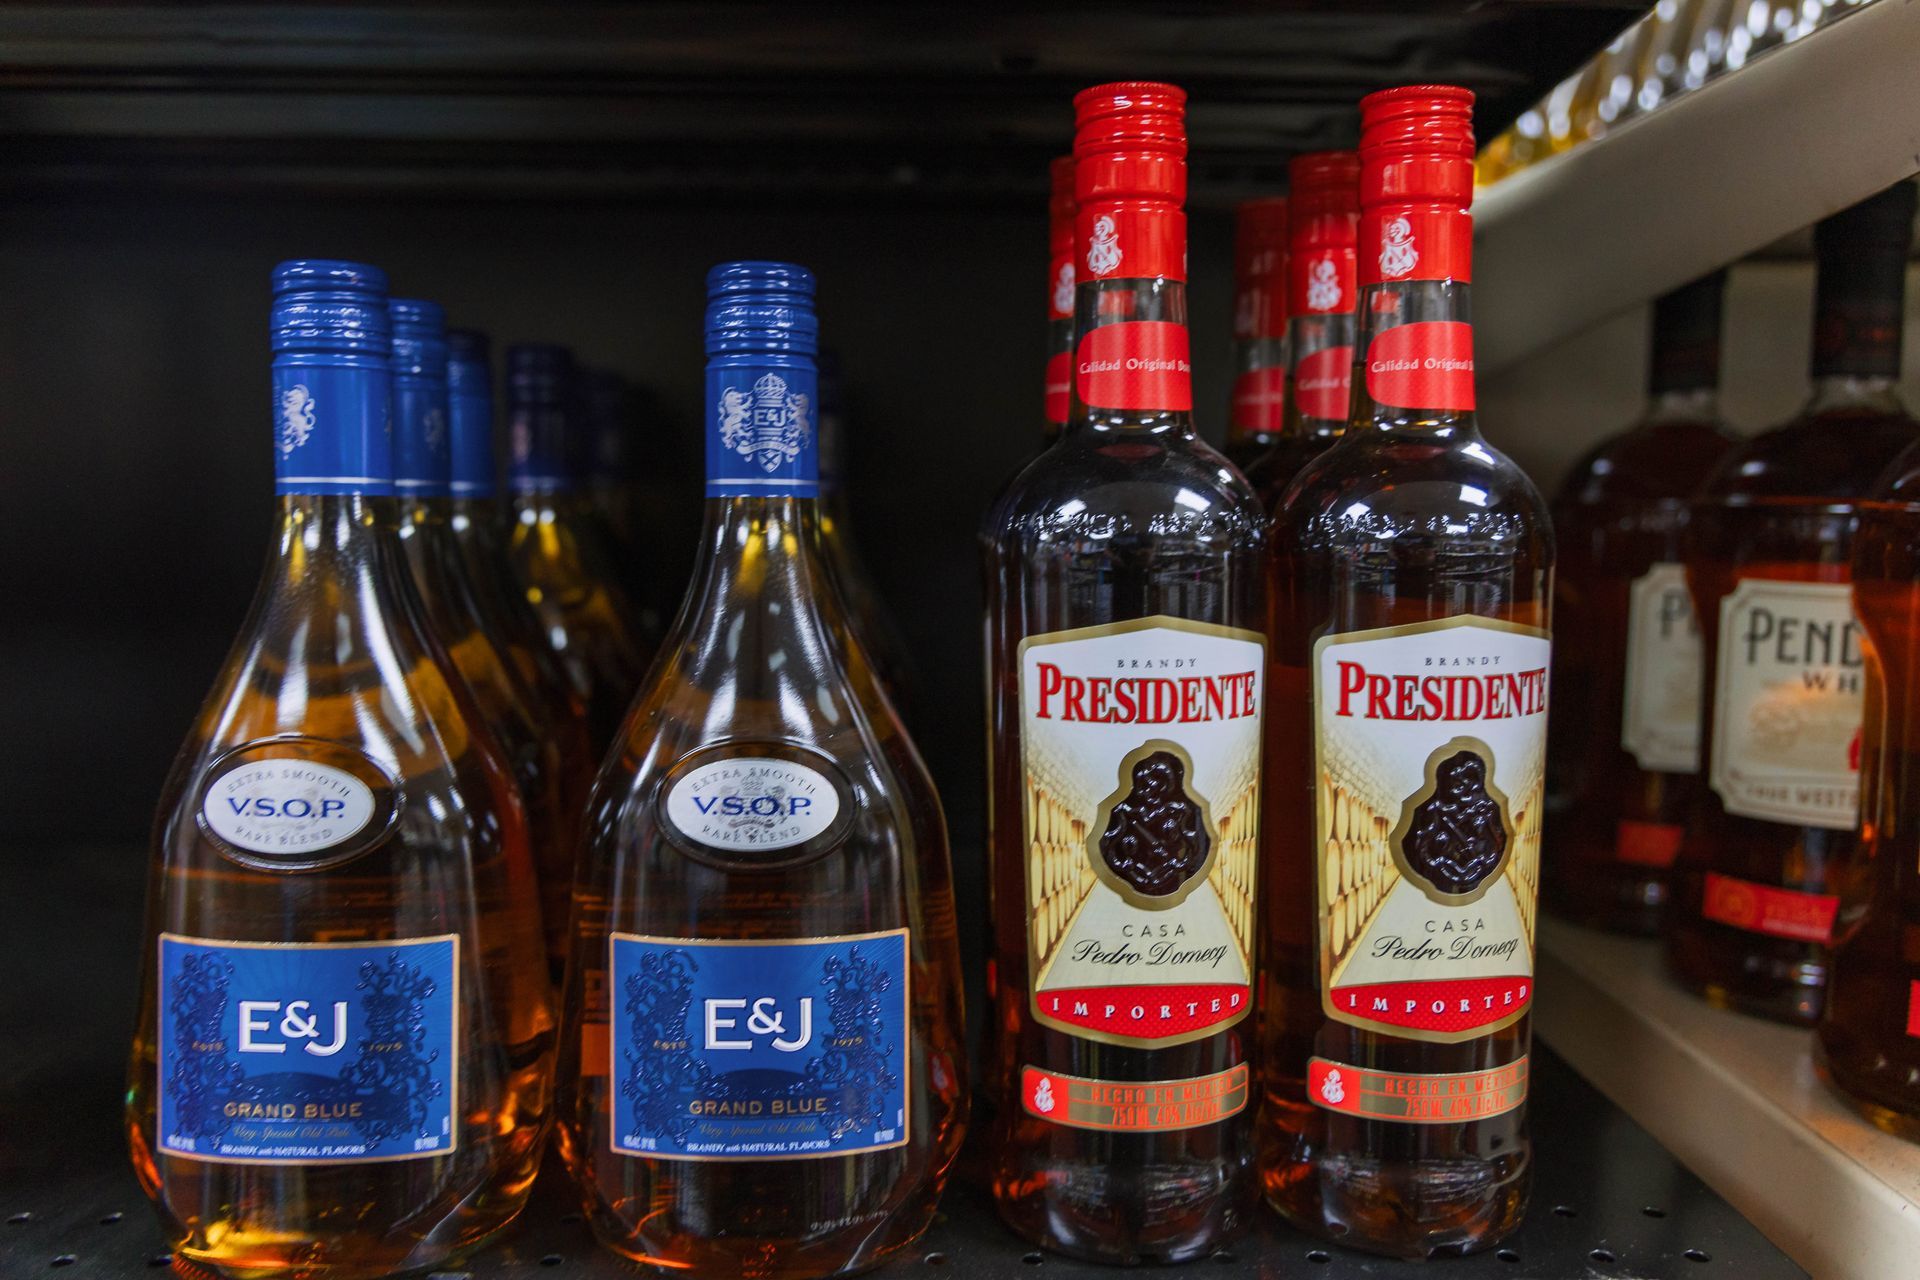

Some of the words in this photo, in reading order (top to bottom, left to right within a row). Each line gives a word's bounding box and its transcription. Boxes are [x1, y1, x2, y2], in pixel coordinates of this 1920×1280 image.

[1080, 358, 1121, 374] Calidad
[1126, 357, 1175, 372] Original
[1371, 358, 1419, 373] Calidad
[753, 408, 787, 428] E&J
[1117, 658, 1198, 669] BRANDY
[1425, 655, 1501, 667] BRANDY
[1036, 661, 1257, 725] PRESIDENTE
[1336, 659, 1546, 722] PRESIDENTE
[226, 768, 276, 794] EXTRA
[282, 768, 352, 798] SMOOTH
[690, 768, 742, 793] EXTRA
[748, 766, 817, 796] SMOOTH
[227, 797, 346, 820] V.S.O.P.
[691, 796, 813, 817] V.S.O.P.
[234, 825, 273, 845] RARE
[702, 825, 742, 844] RARE
[749, 825, 802, 844] BLEND
[1122, 923, 1186, 938] CASA
[1424, 917, 1485, 934] CASA
[1071, 938, 1143, 966] Pedro
[1145, 940, 1229, 969] Domecq
[1371, 935, 1445, 961] Pedro
[1447, 935, 1520, 962] Domecq
[1053, 992, 1240, 1021] IMPORTED
[1350, 985, 1528, 1015] IMPORTED
[238, 1000, 348, 1057] E&J
[704, 997, 813, 1051] E&J
[1091, 1086, 1147, 1104] HECHO
[1155, 1088, 1175, 1103] EN
[1384, 1078, 1440, 1096] HECHO
[1449, 1080, 1467, 1095] EN
[222, 1102, 297, 1119] GRAND
[303, 1102, 363, 1119] BLUE
[688, 1099, 763, 1115] GRAND
[771, 1097, 828, 1114] BLUE
[1155, 1104, 1181, 1125] 40%
[220, 1143, 259, 1156] BRANDY
[272, 1144, 321, 1157] NATURAL
[321, 1143, 367, 1156] FLAVORS
[686, 1141, 726, 1153] BRANDY
[741, 1142, 788, 1153] NATURAL
[788, 1139, 832, 1151] FLAVORS
